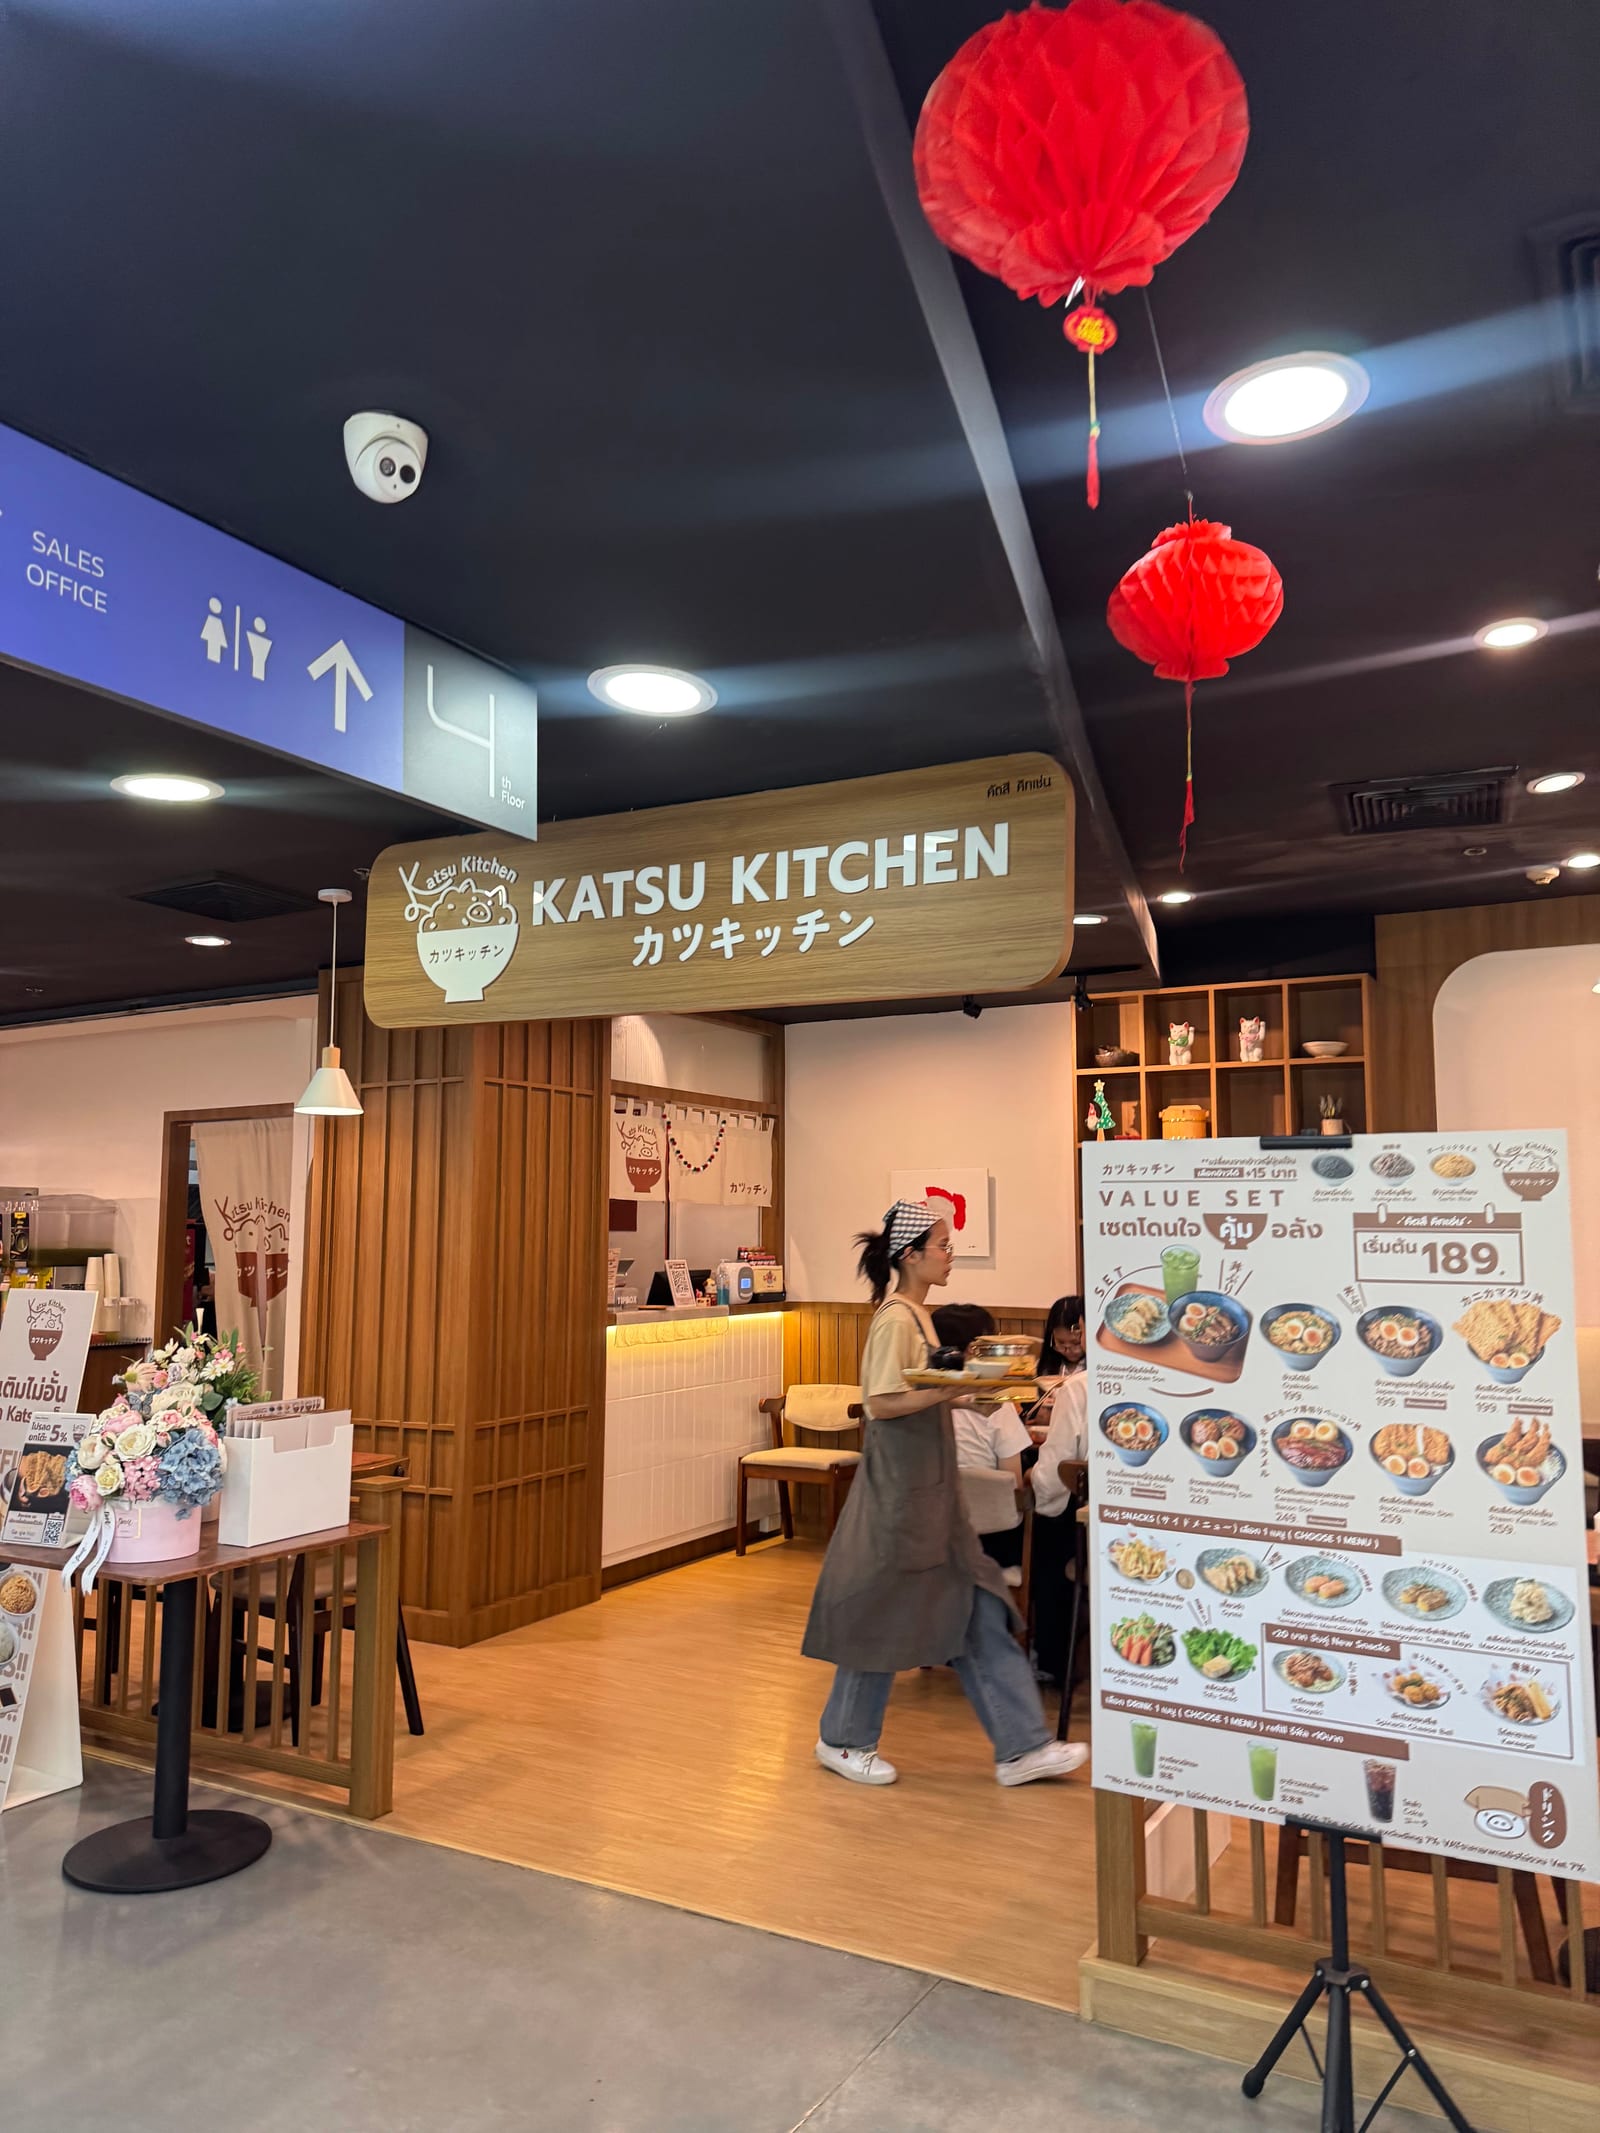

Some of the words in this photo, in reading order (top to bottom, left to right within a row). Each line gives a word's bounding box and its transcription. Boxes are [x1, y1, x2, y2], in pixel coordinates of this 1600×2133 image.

[31, 531, 105, 578] SALES
[26, 564, 108, 614] OFFICE
[427, 664, 495, 799] 4
[502, 775, 512, 790] th
[501, 790, 525, 810] Floor
[461, 855, 519, 884] Kitchen
[532, 861, 705, 926] KATSU
[732, 822, 1010, 904] KITCHEN
[633, 908, 875, 967] カツキッチン
[428, 944, 505, 964] カツキッチン
[1101, 1163, 1175, 1177] カツキッチン
[1099, 1190, 1201, 1207] VALUE
[1224, 1189, 1285, 1207] SET
[1099, 1216, 1202, 1238] เซตโดนใจ
[1219, 1214, 1254, 1246] คุ้ม
[1271, 1216, 1324, 1239] อลัง
[1363, 1235, 1418, 1255] เริ่มต้น
[1094, 1266, 1124, 1297] SET
[1540, 1787, 1556, 1844] ドリンク
